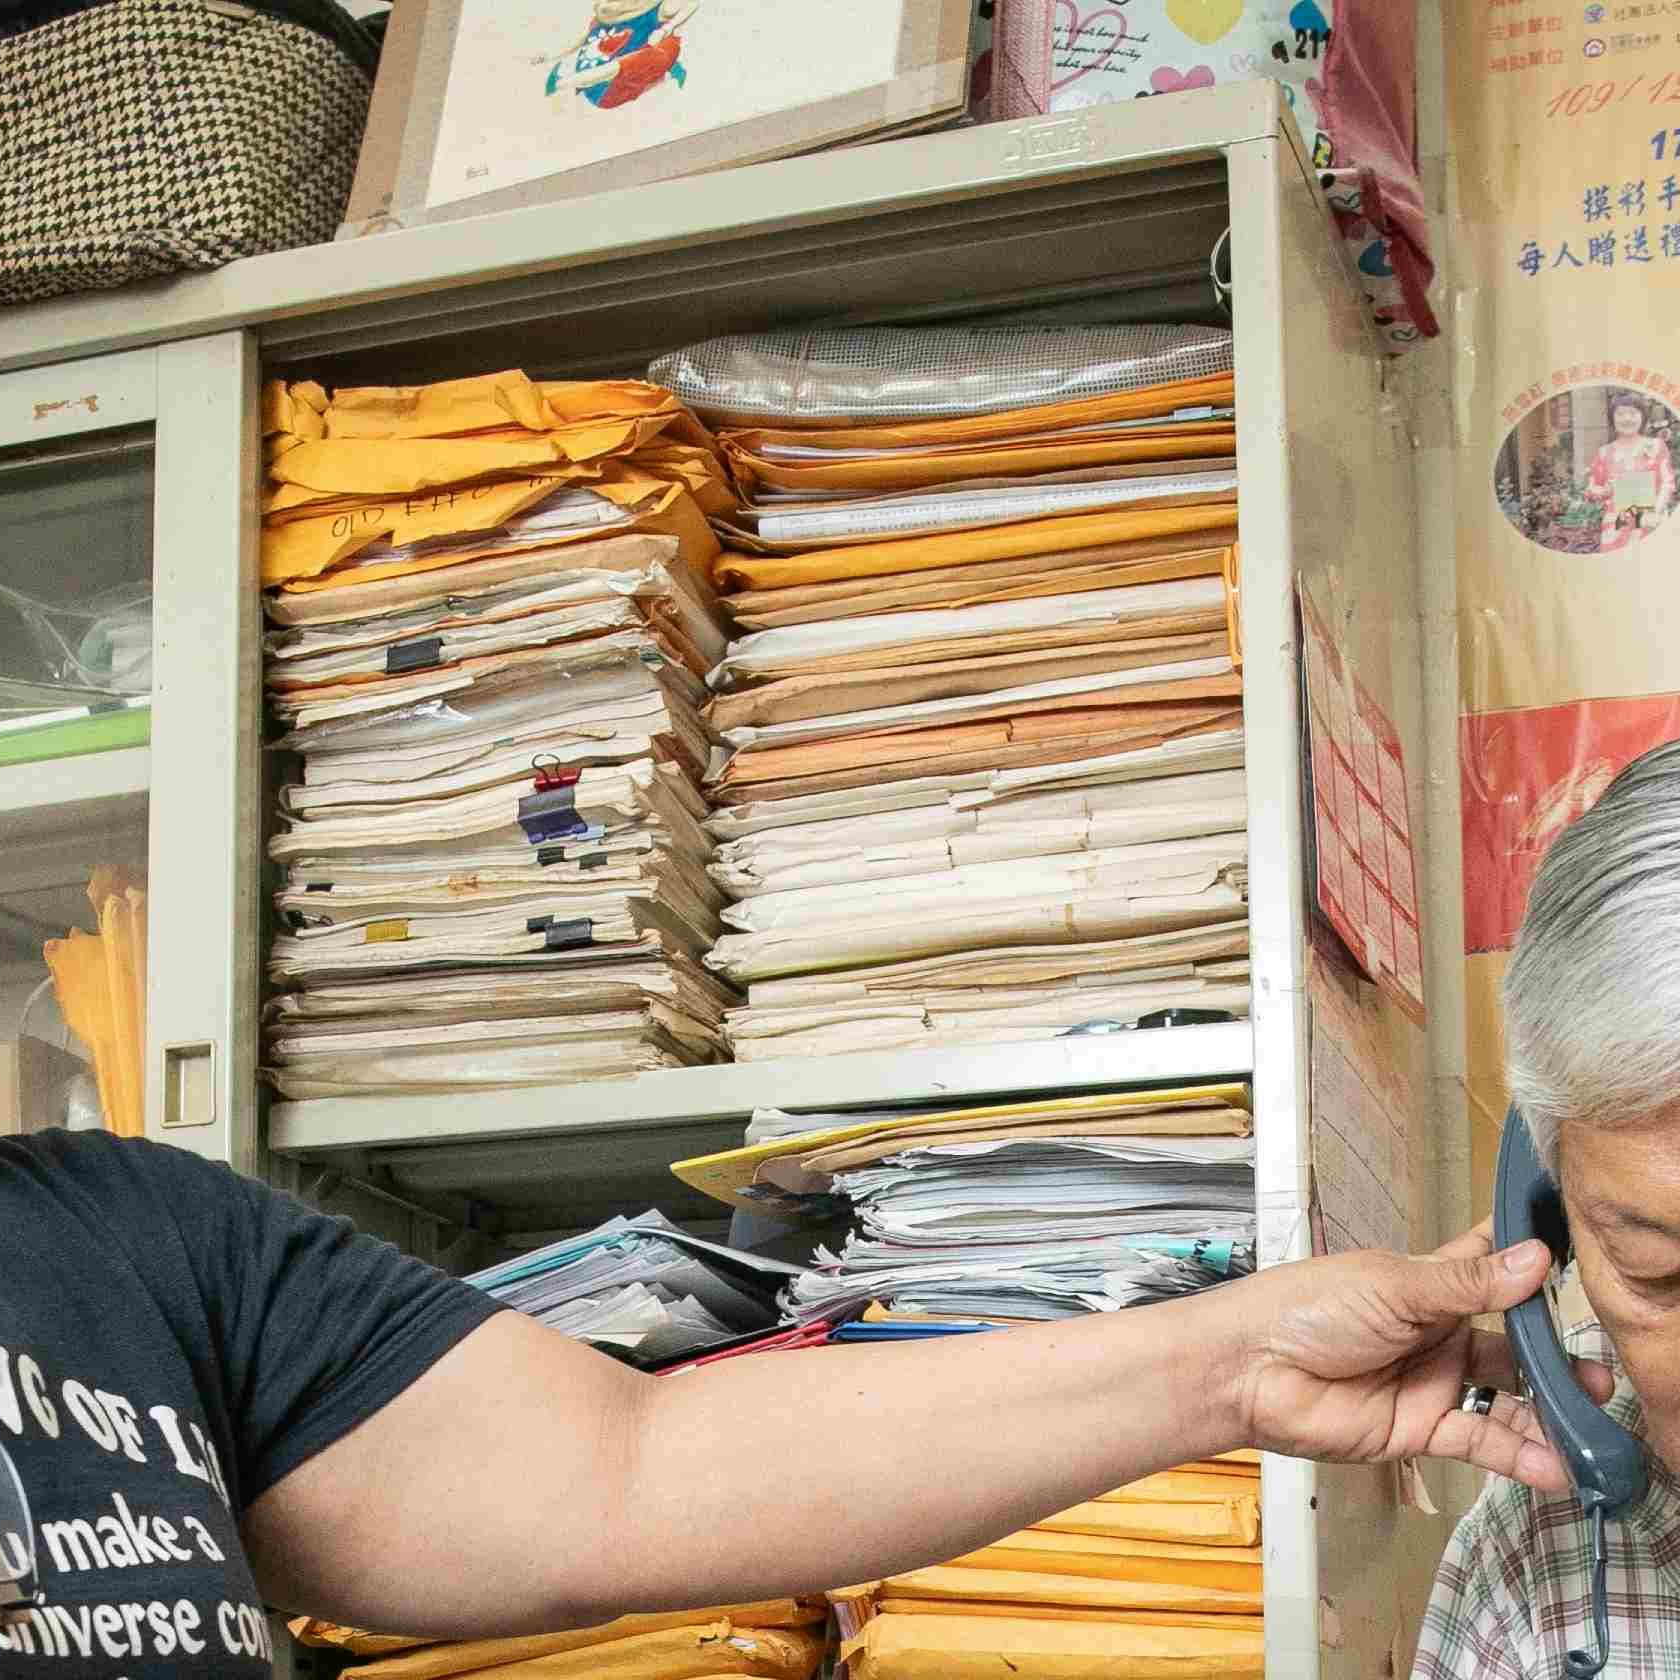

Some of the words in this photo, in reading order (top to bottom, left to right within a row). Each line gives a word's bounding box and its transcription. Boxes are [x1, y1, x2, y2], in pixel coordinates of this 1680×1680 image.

[62, 1379, 148, 1463] OF
[41, 1492, 193, 1573] make
[184, 1515, 226, 1562] a
